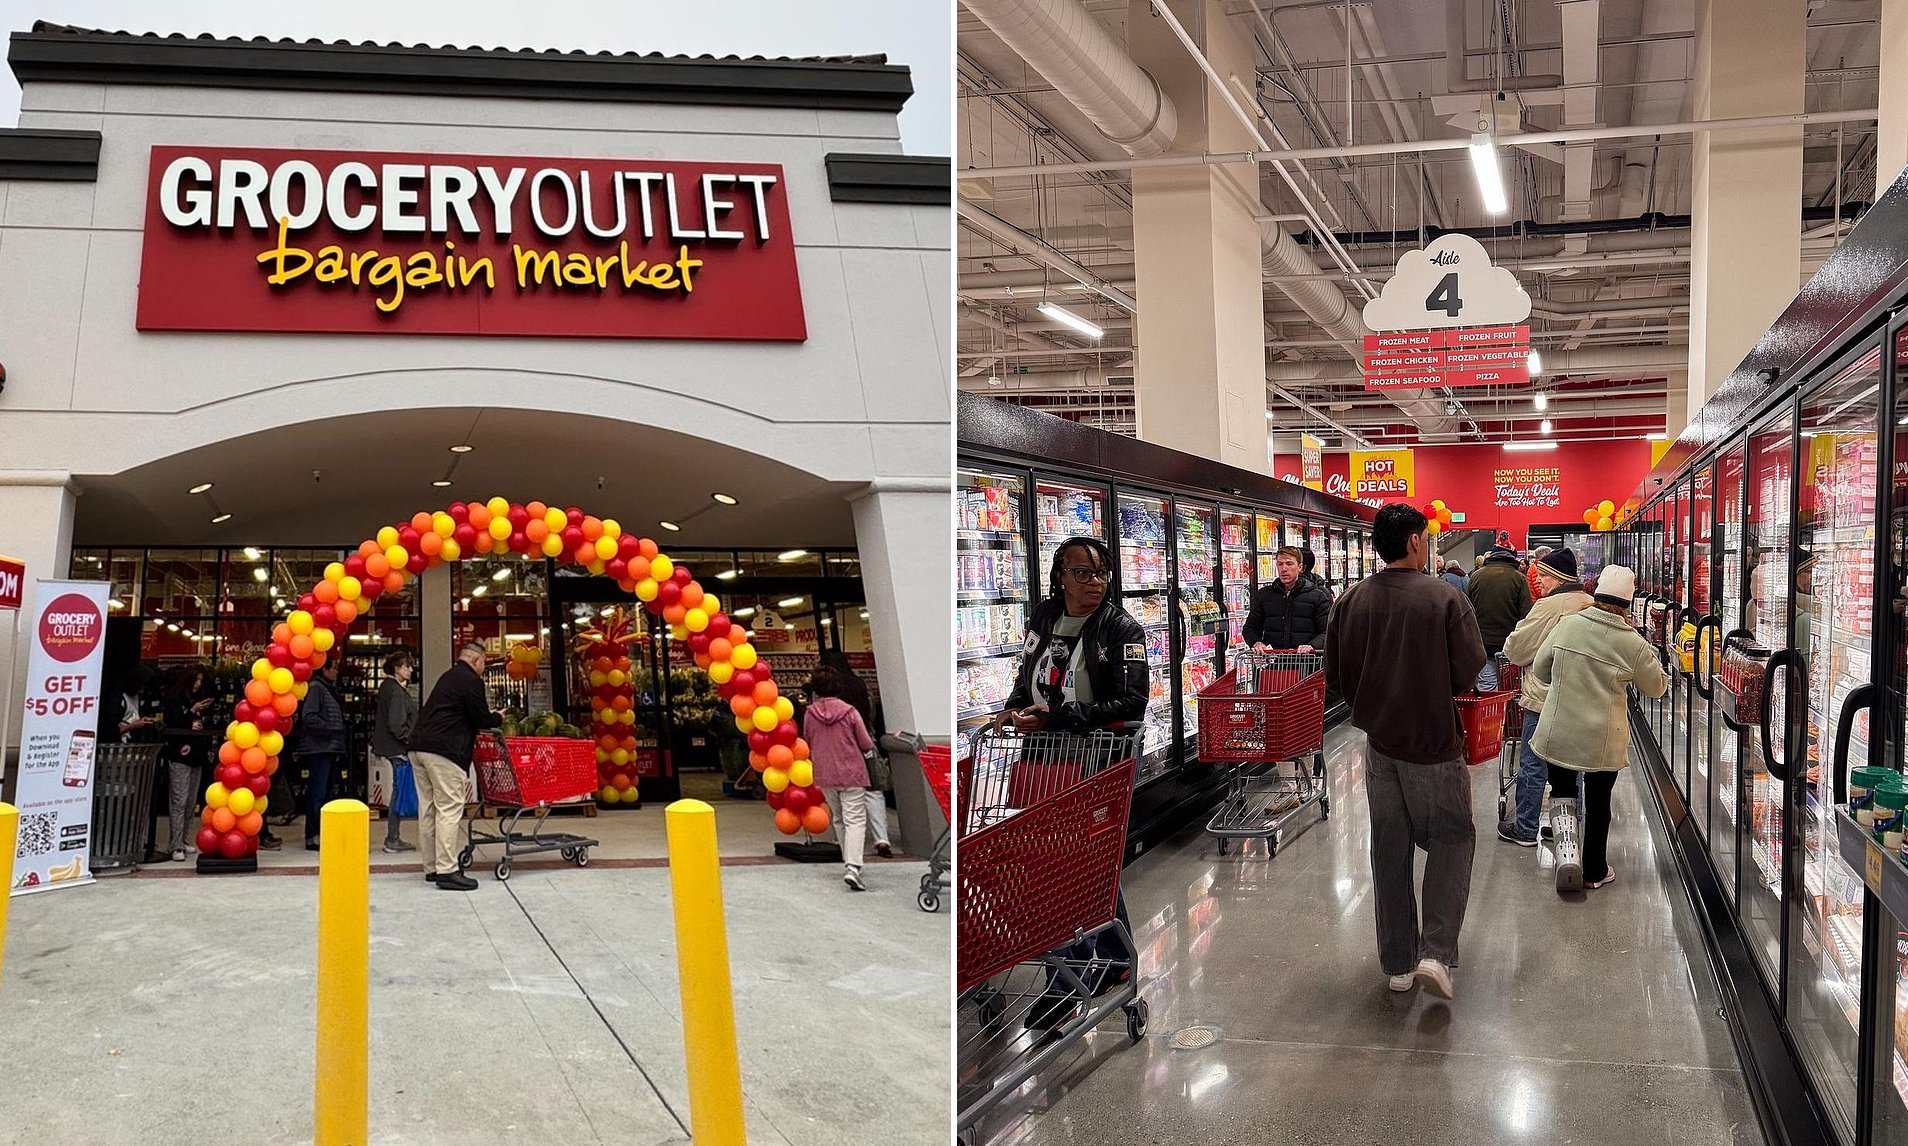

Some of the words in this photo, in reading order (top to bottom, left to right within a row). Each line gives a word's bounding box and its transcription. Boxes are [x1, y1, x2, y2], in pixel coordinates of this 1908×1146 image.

[1429, 249, 1461, 267] Aisle
[255, 216, 496, 312] bargain
[514, 239, 703, 293] market
[1425, 272, 1463, 318] 4
[1378, 338, 1407, 346] FROZEN
[1409, 336, 1430, 345] MEAT
[1459, 332, 1491, 341] FROZEN
[1493, 331, 1517, 339] FRUIT
[1371, 357, 1402, 367] FROZEN
[1404, 356, 1439, 365] CHICKEN
[1447, 354, 1479, 363] FROZEN
[1369, 377, 1400, 386] FROZEN
[1403, 375, 1441, 385] SEAFOOD
[1475, 372, 1499, 380] PIZZA
[1303, 449, 1319, 464] SUPER
[1304, 464, 1320, 479] SAVER
[1364, 460, 1394, 472] HOT
[1515, 468, 1533, 476] YOU
[1357, 479, 1407, 493] DEALS
[1494, 484, 1530, 499] Today's
[1531, 484, 1560, 497] Deals
[1508, 498, 1521, 506] Too
[1521, 498, 1536, 506] Hot
[47, 612, 97, 625] GROCERY
[764, 616, 773, 627] 2
[53, 624, 88, 637] OUTLET
[44, 675, 87, 693] GET
[25, 697, 48, 716] $5
[29, 734, 47, 742] When
[48, 733, 60, 743] you
[28, 743, 60, 752] Download
[33, 751, 60, 761] Register
[24, 762, 35, 770] for
